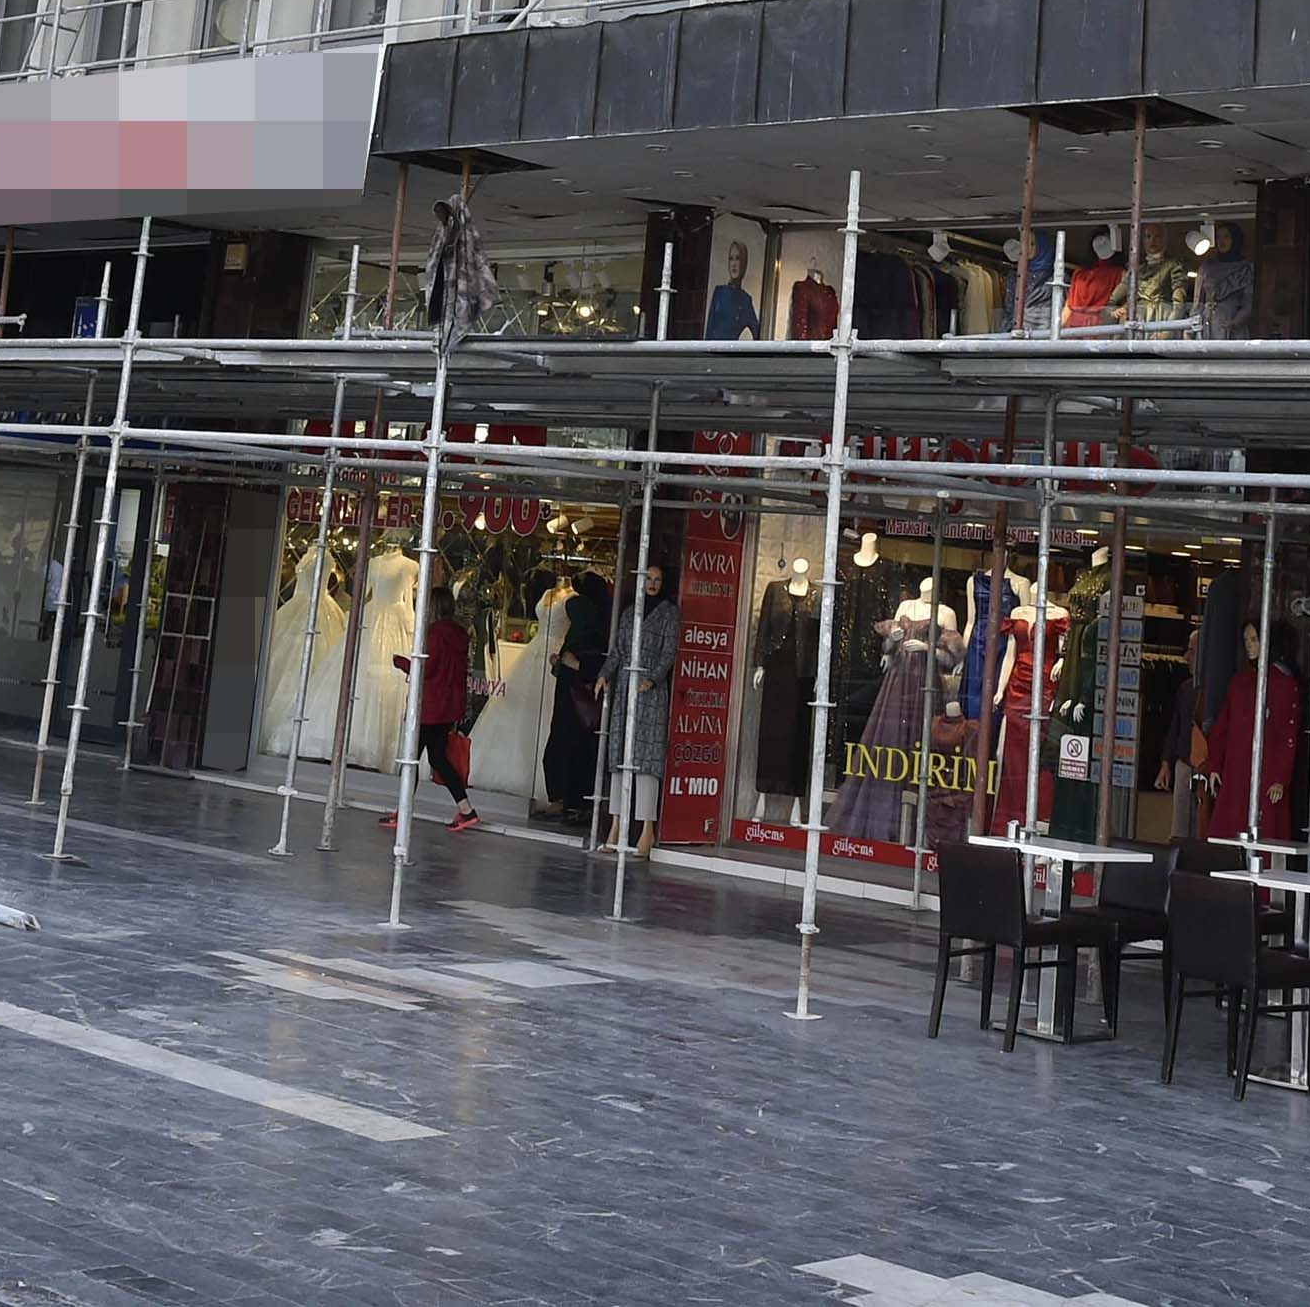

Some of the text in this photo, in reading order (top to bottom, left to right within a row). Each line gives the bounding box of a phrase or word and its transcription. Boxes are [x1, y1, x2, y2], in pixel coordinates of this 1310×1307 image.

[690, 550, 737, 575] KAYRA
[685, 625, 728, 650] alesya
[680, 655, 728, 680] NİHAN
